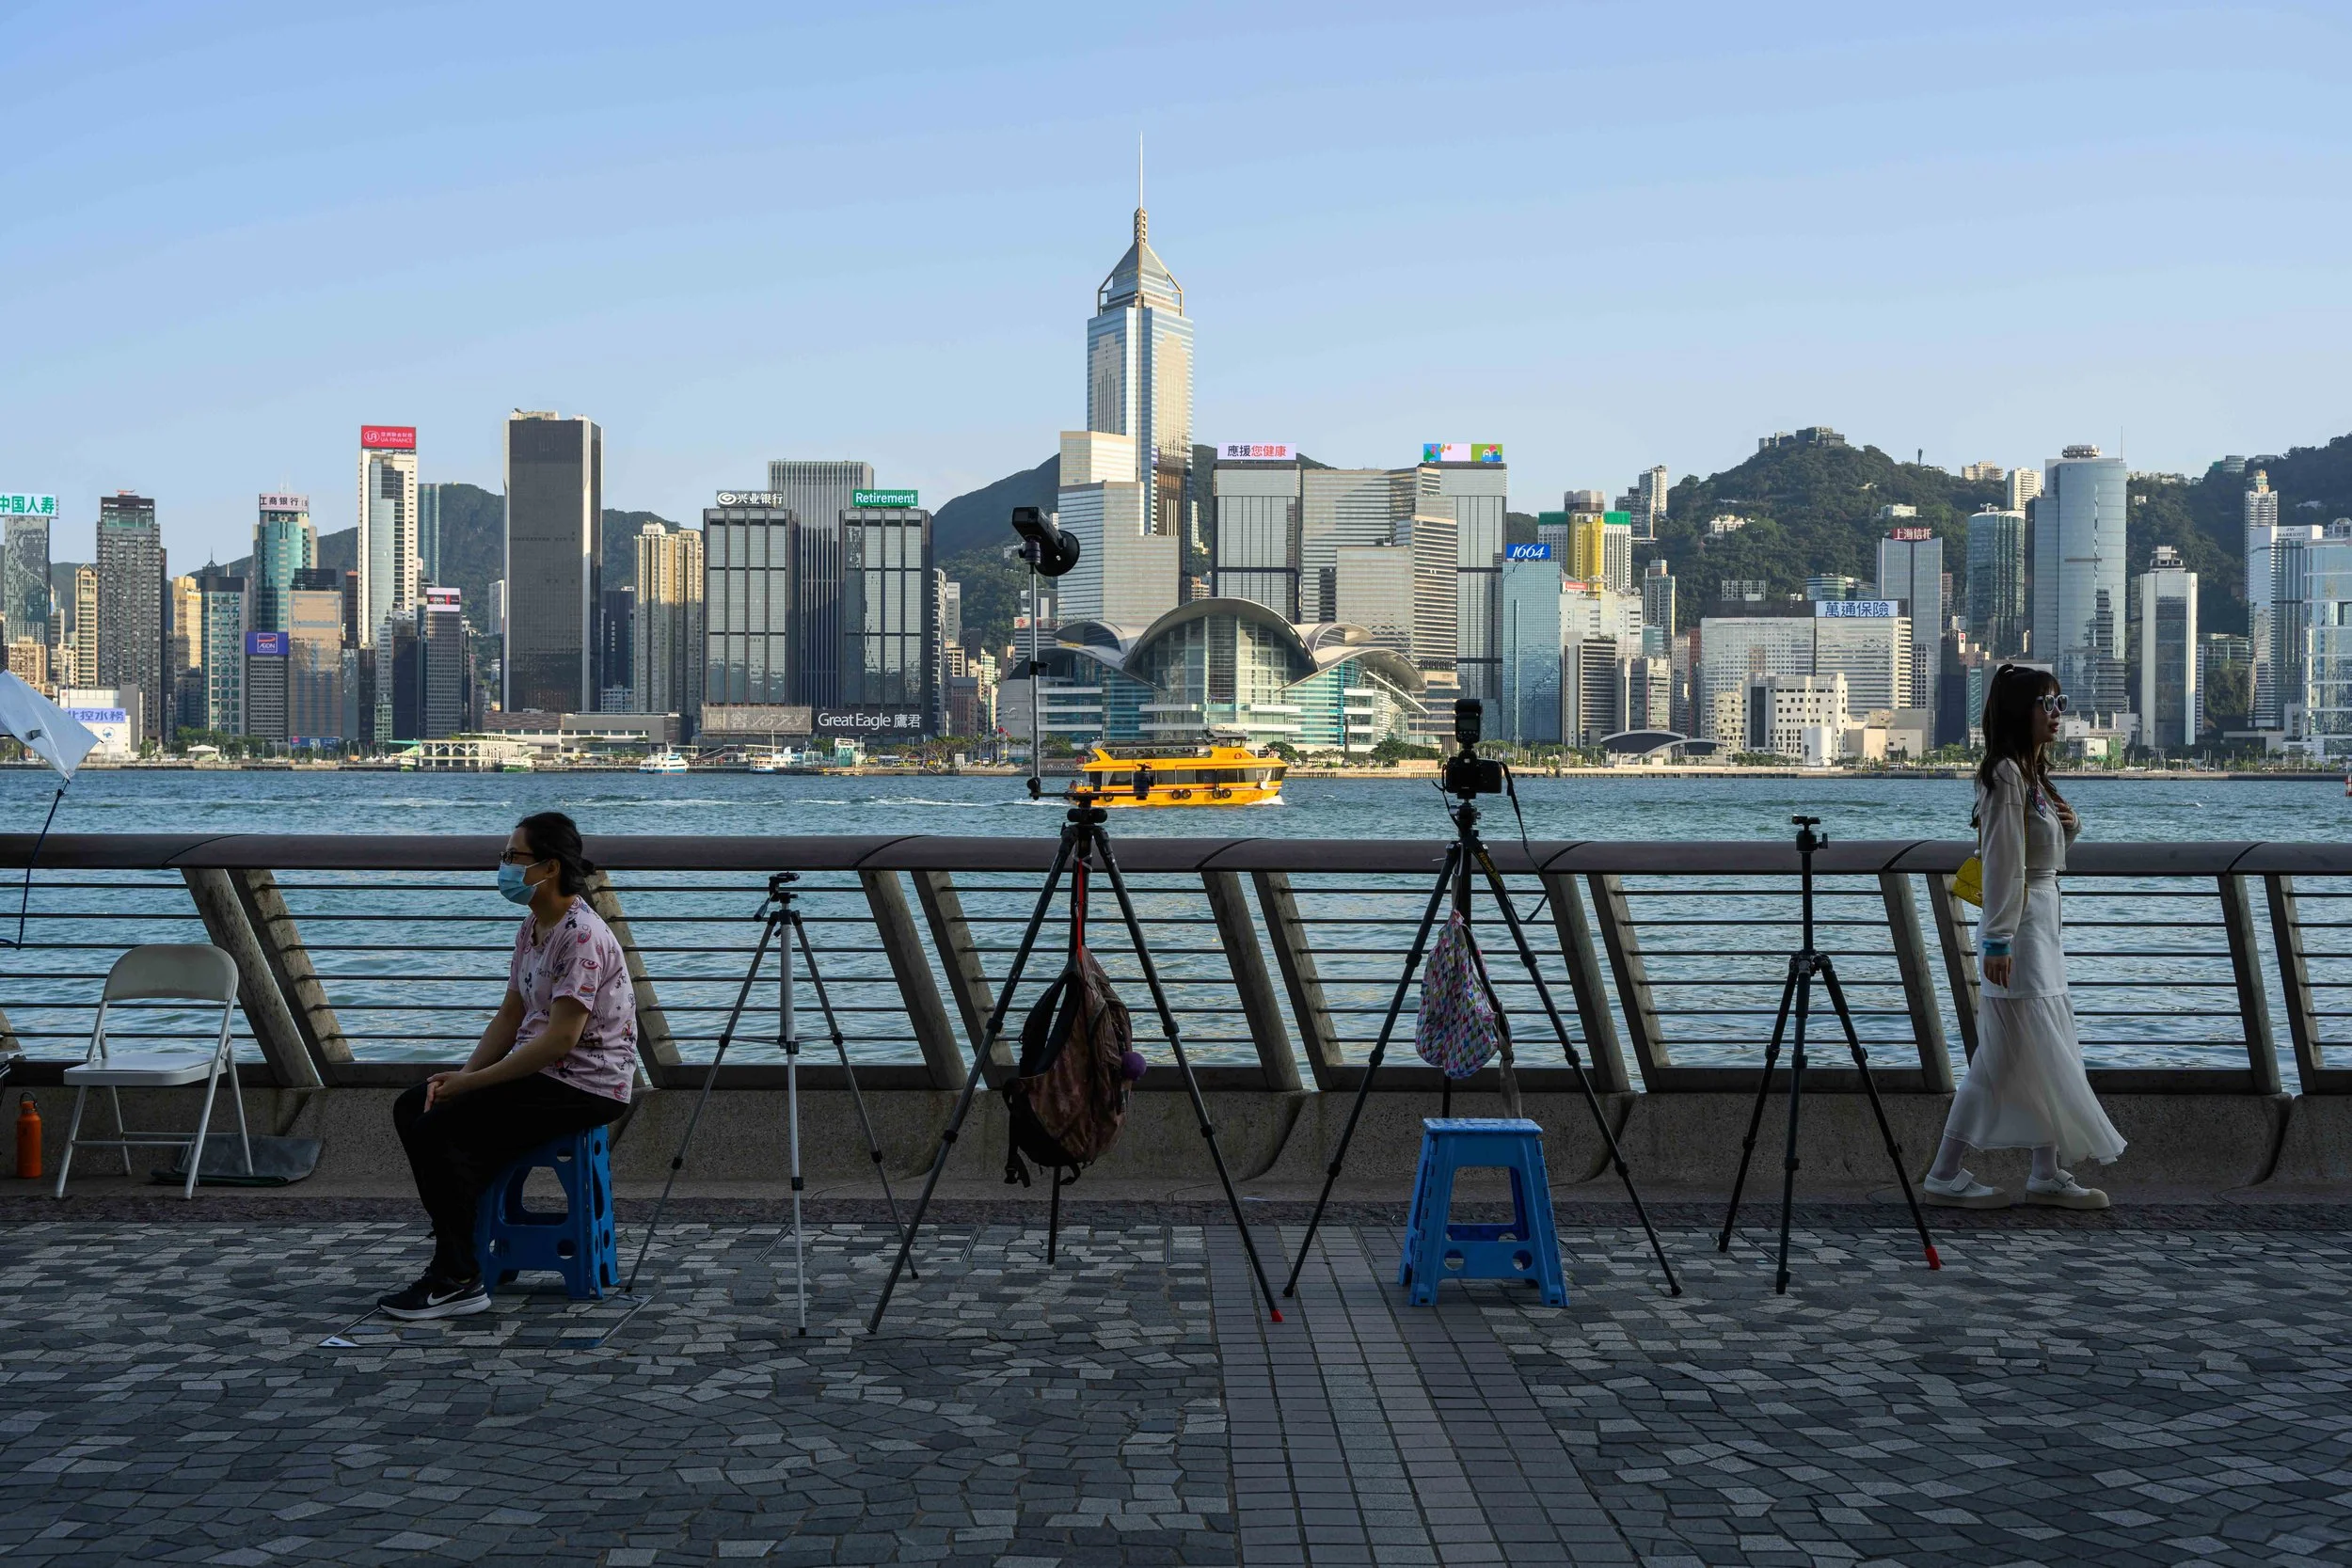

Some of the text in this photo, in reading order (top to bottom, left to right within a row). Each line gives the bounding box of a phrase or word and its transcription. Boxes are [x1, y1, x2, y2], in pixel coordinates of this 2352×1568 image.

[0, 495, 55, 514] 中国人寿
[737, 493, 783, 504] 兴业银行
[856, 492, 915, 504] Retirement
[1512, 545, 1545, 558] 1664
[1825, 602, 1889, 617] 萬通保險
[818, 712, 922, 731] Great Eagle 鷹君
